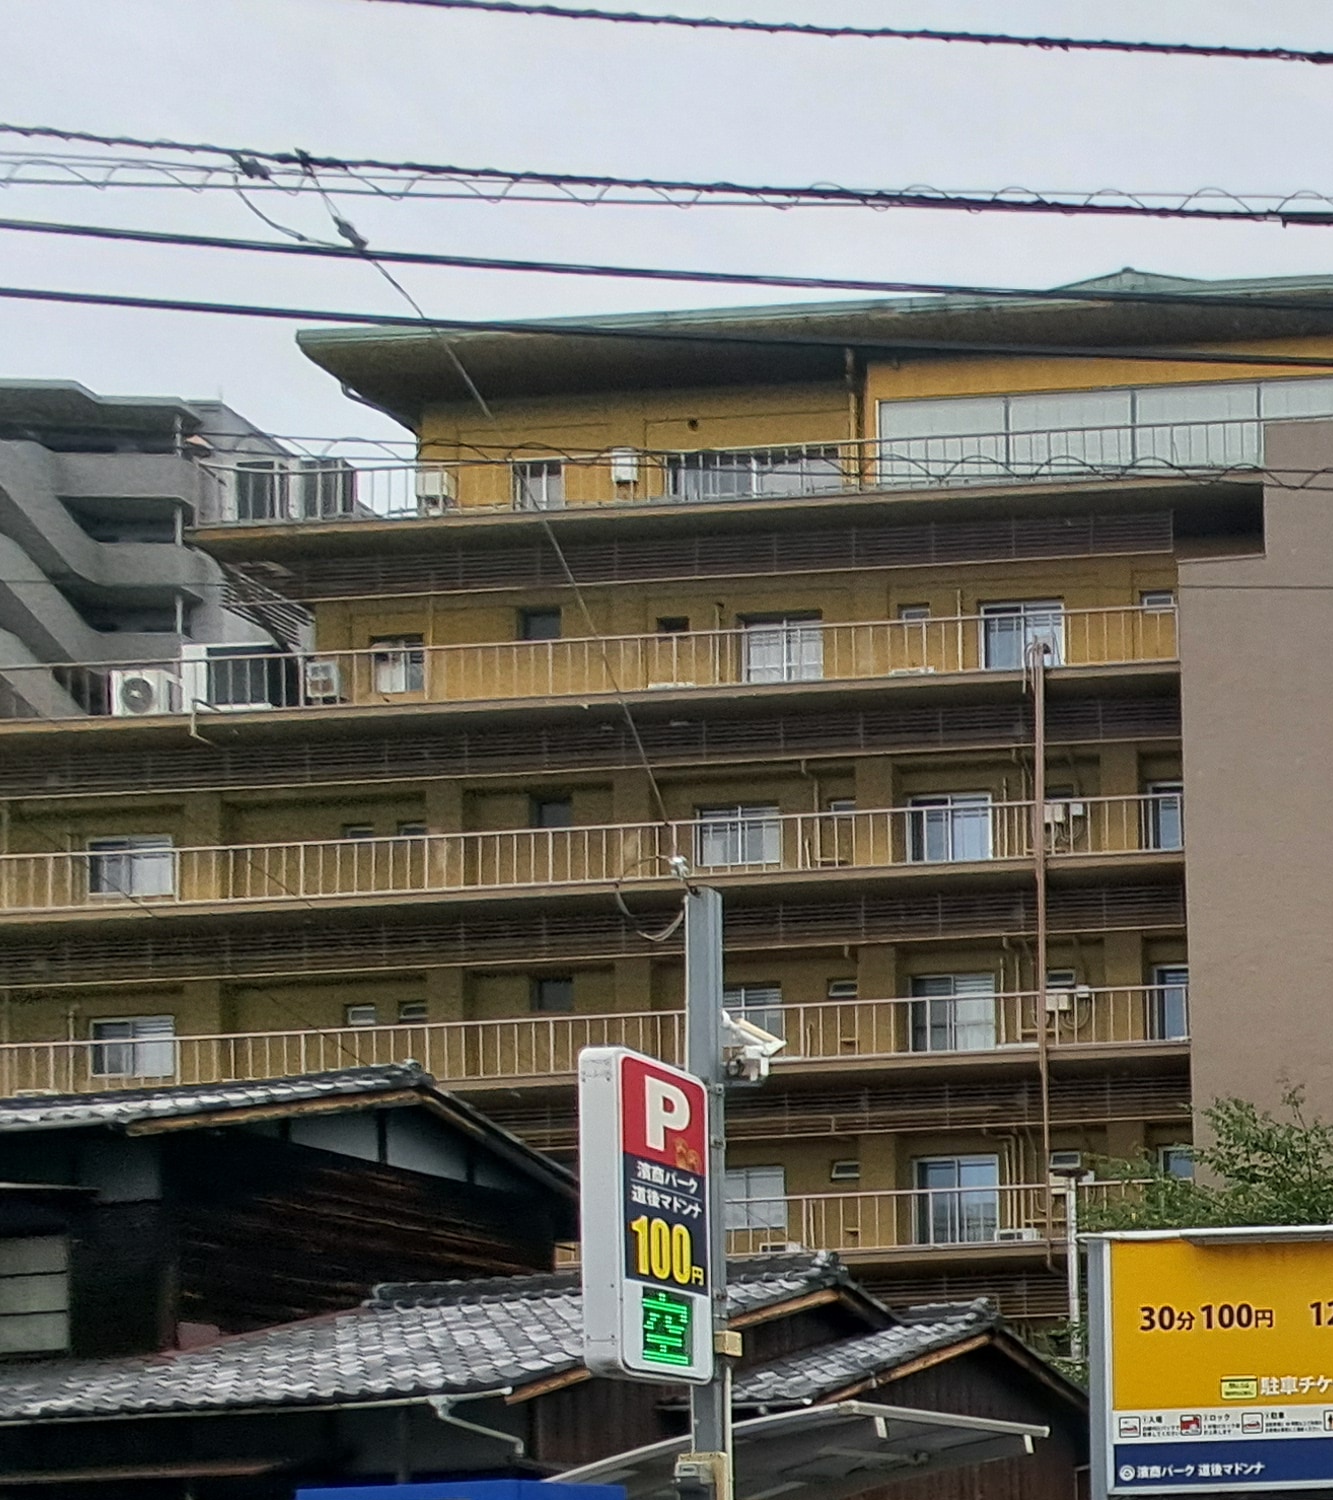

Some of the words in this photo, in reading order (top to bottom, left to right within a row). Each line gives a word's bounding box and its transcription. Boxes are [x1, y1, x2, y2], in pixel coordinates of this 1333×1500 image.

[645, 1074, 690, 1151] P
[631, 1185, 702, 1219] 道後マドンナ
[630, 1215, 705, 1286] 100円
[642, 1294, 688, 1366] 空
[1198, 1462, 1266, 1478] 道後マドンナ
